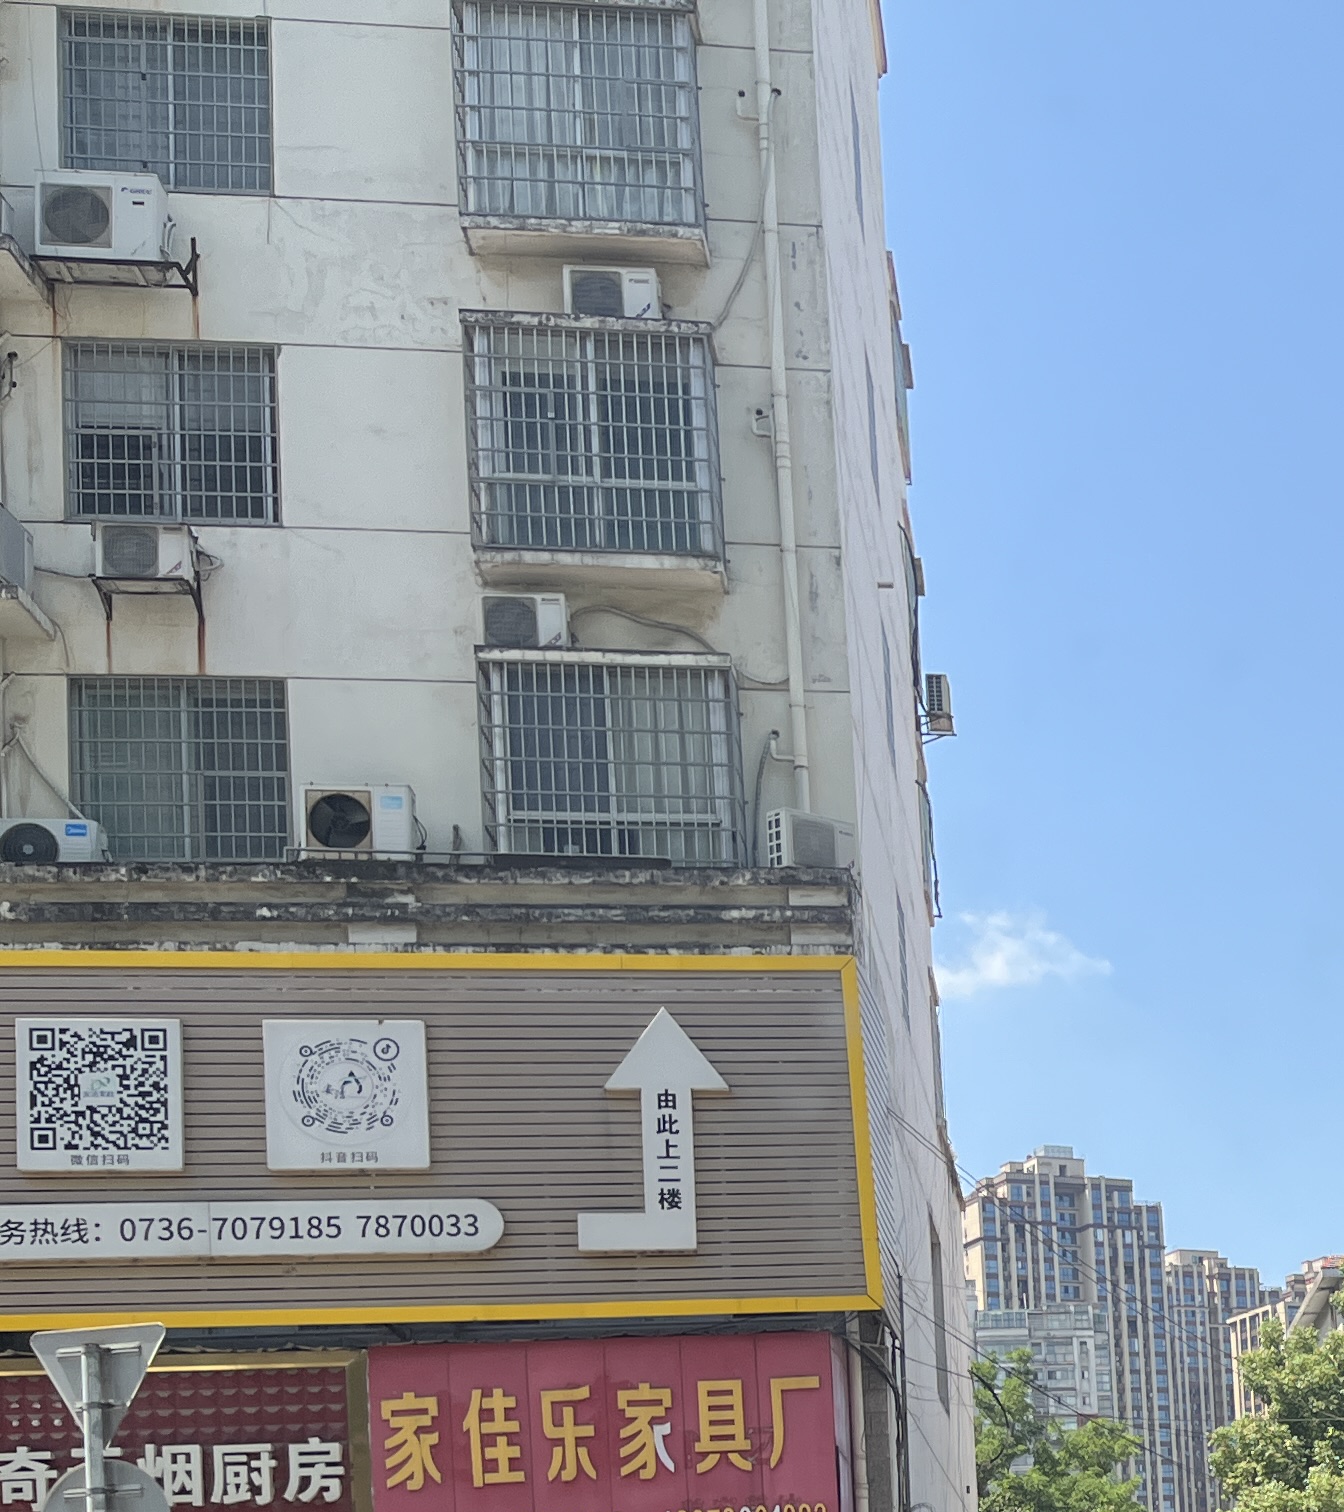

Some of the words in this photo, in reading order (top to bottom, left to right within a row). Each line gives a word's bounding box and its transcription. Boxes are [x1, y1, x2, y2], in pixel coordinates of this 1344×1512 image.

[70, 1153, 131, 1167] 微信扫码
[320, 1151, 379, 1164] 抖音扫码
[655, 1088, 683, 1211] 由此上二楼
[356, 1211, 480, 1240] 7870033
[380, 1375, 820, 1491] 家佳乐家具厂
[0, 1437, 346, 1512] 奇烟厨房
